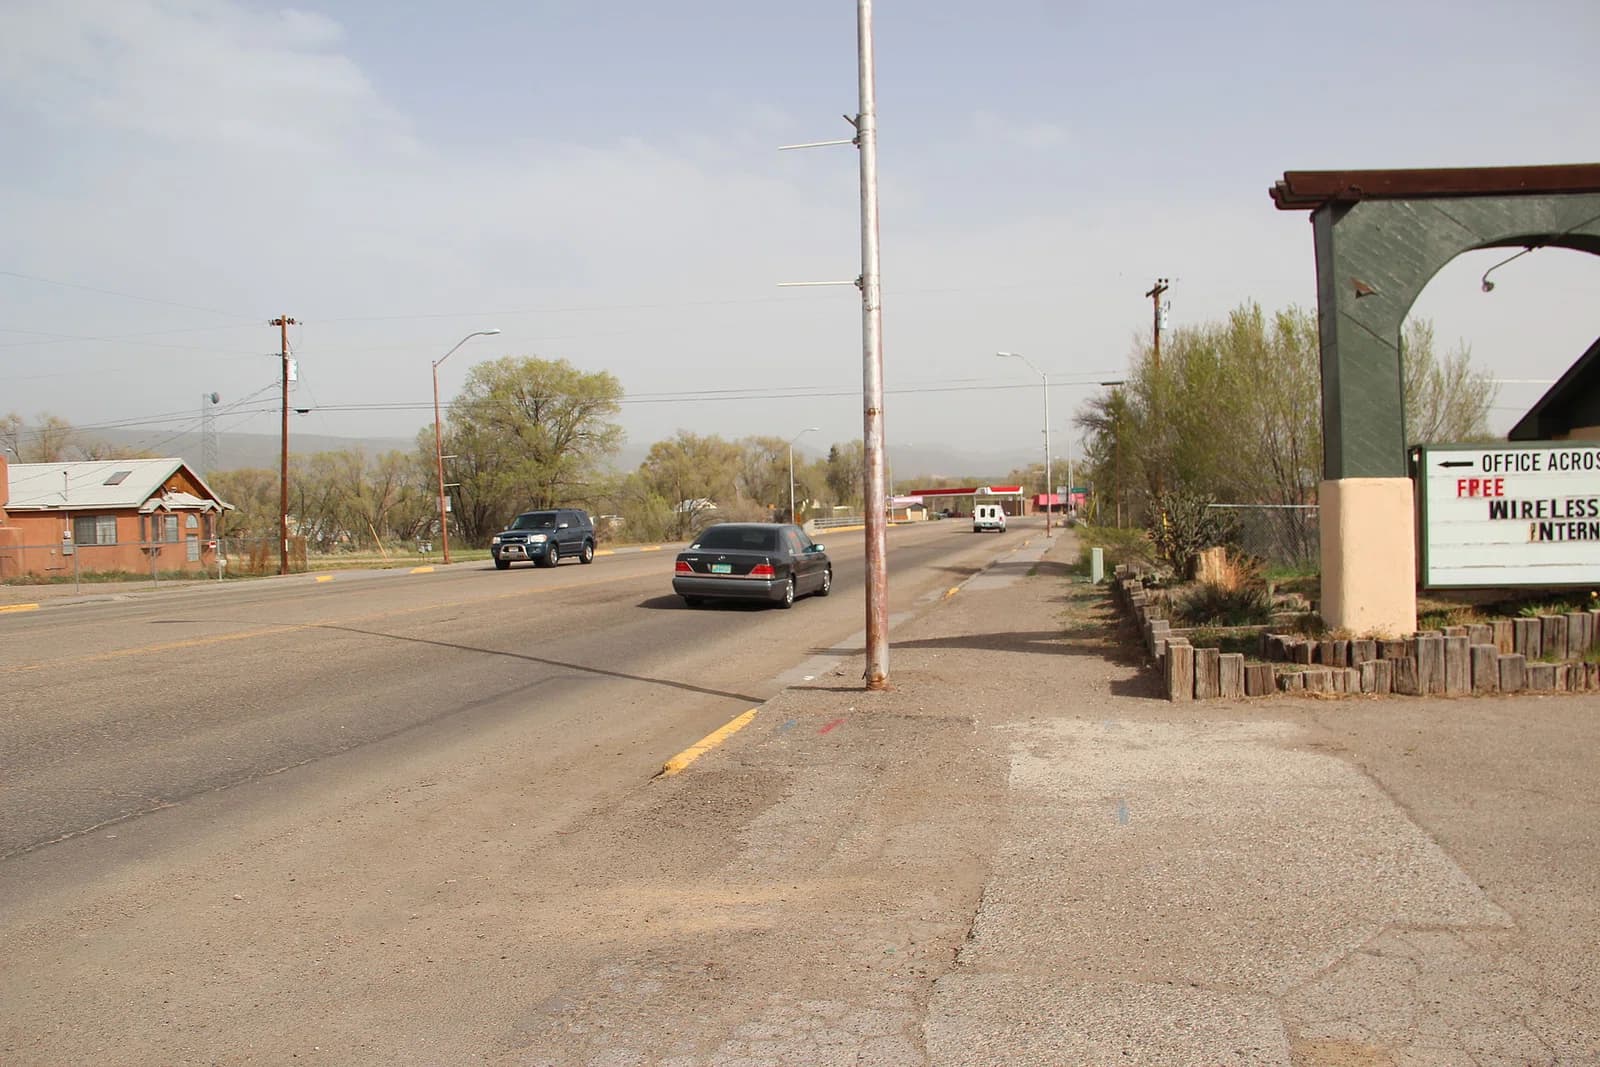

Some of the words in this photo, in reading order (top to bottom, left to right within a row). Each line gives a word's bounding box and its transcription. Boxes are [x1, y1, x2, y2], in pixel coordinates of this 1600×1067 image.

[1482, 453, 1541, 472] OFFICE
[1457, 478, 1504, 497] FREE
[1489, 499, 1598, 520] WIRELESS
[1530, 521, 1600, 541] INTERN
